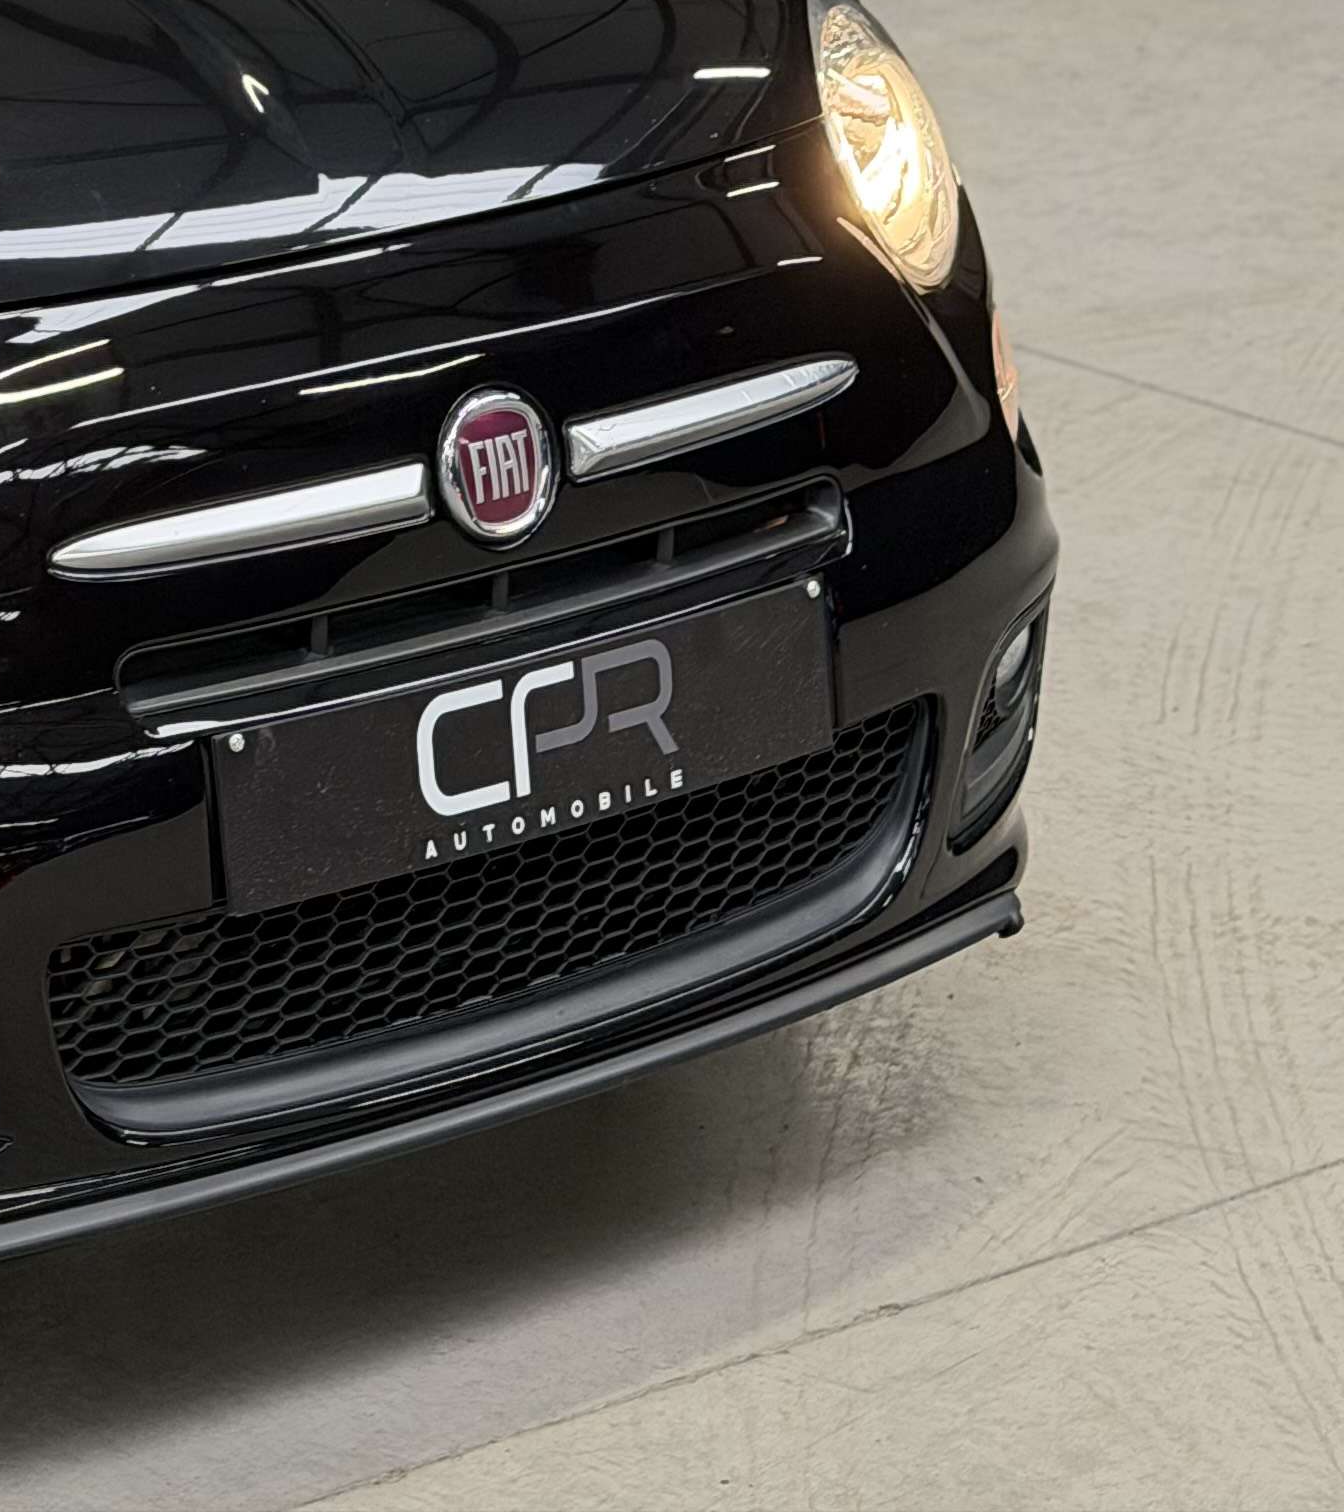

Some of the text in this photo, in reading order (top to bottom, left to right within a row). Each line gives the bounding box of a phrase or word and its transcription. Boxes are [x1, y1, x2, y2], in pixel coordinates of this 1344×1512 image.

[468, 429, 529, 504] FIAT
[416, 639, 680, 816] CPR
[425, 768, 684, 860] AUTOMOBILE
